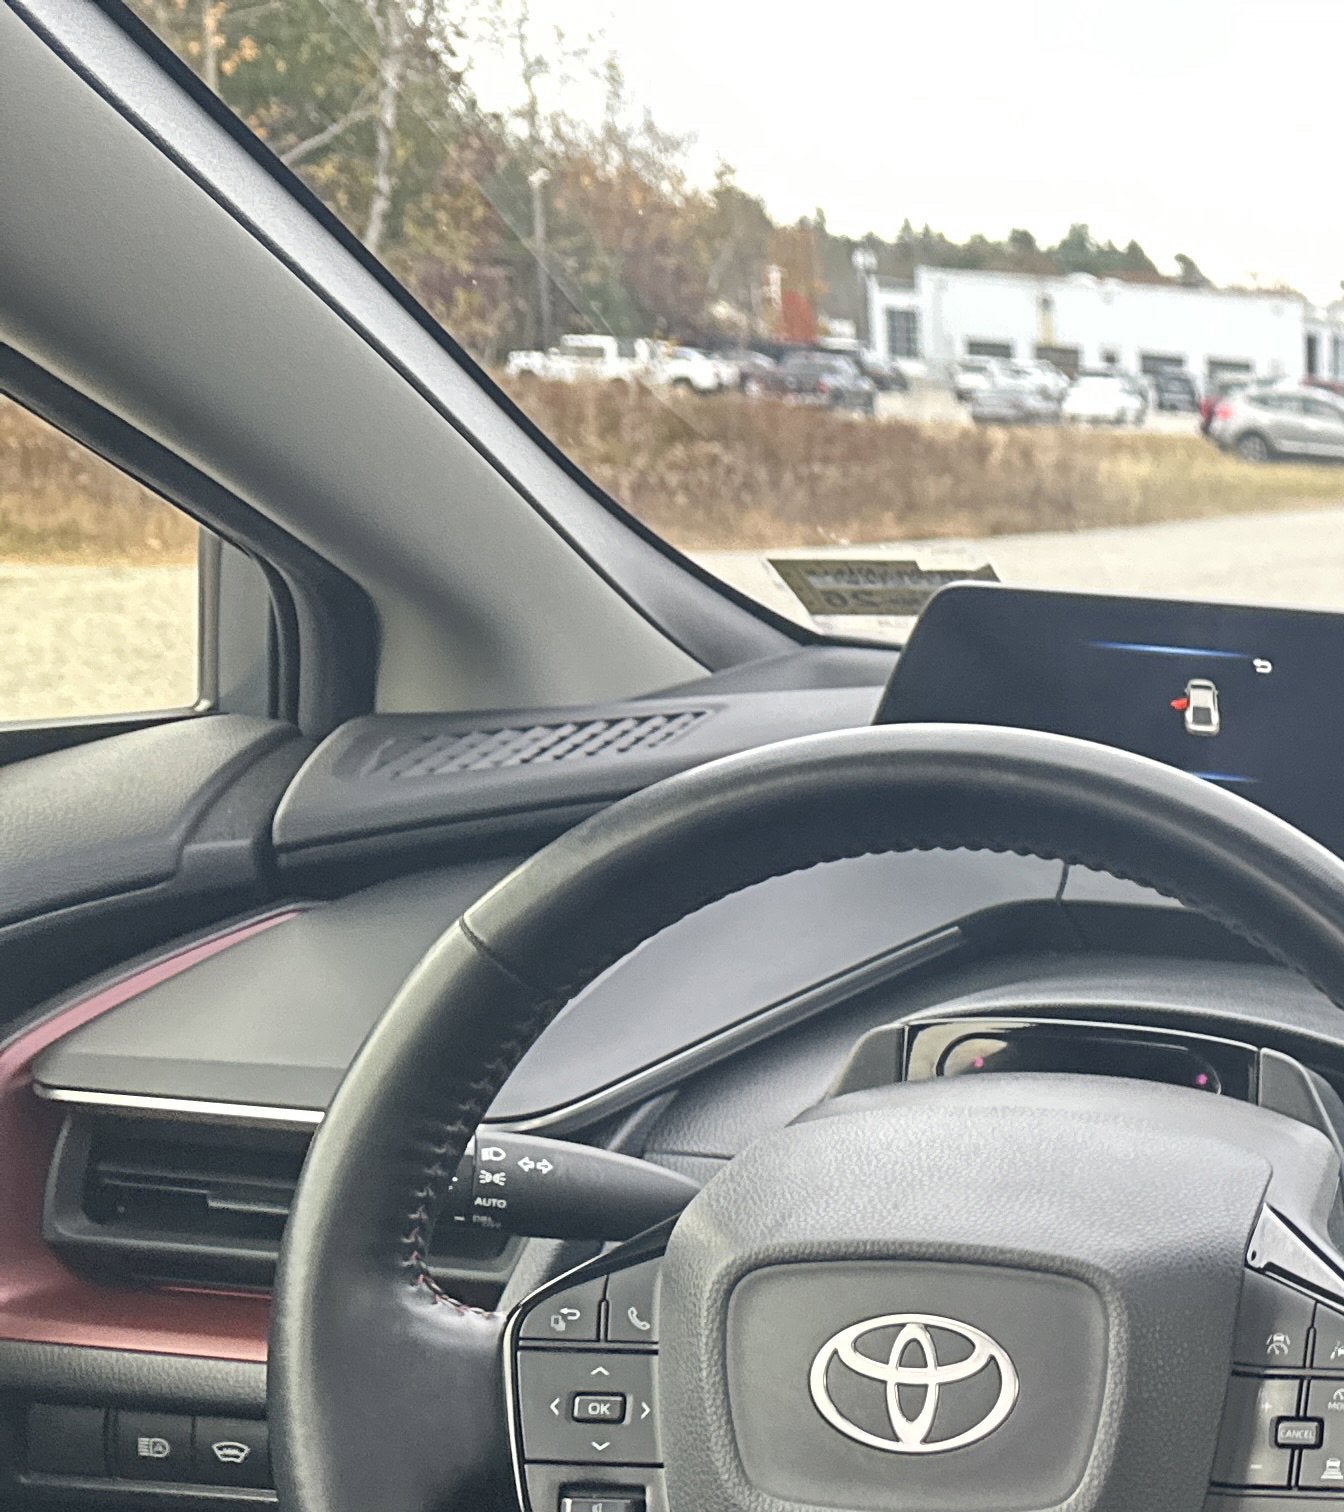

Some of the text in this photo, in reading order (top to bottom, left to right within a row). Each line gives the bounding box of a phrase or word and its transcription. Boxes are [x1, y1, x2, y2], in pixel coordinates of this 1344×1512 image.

[474, 1196, 507, 1209] AUTO
[588, 1403, 610, 1415] OK
[1280, 1428, 1314, 1440] CANCEL
